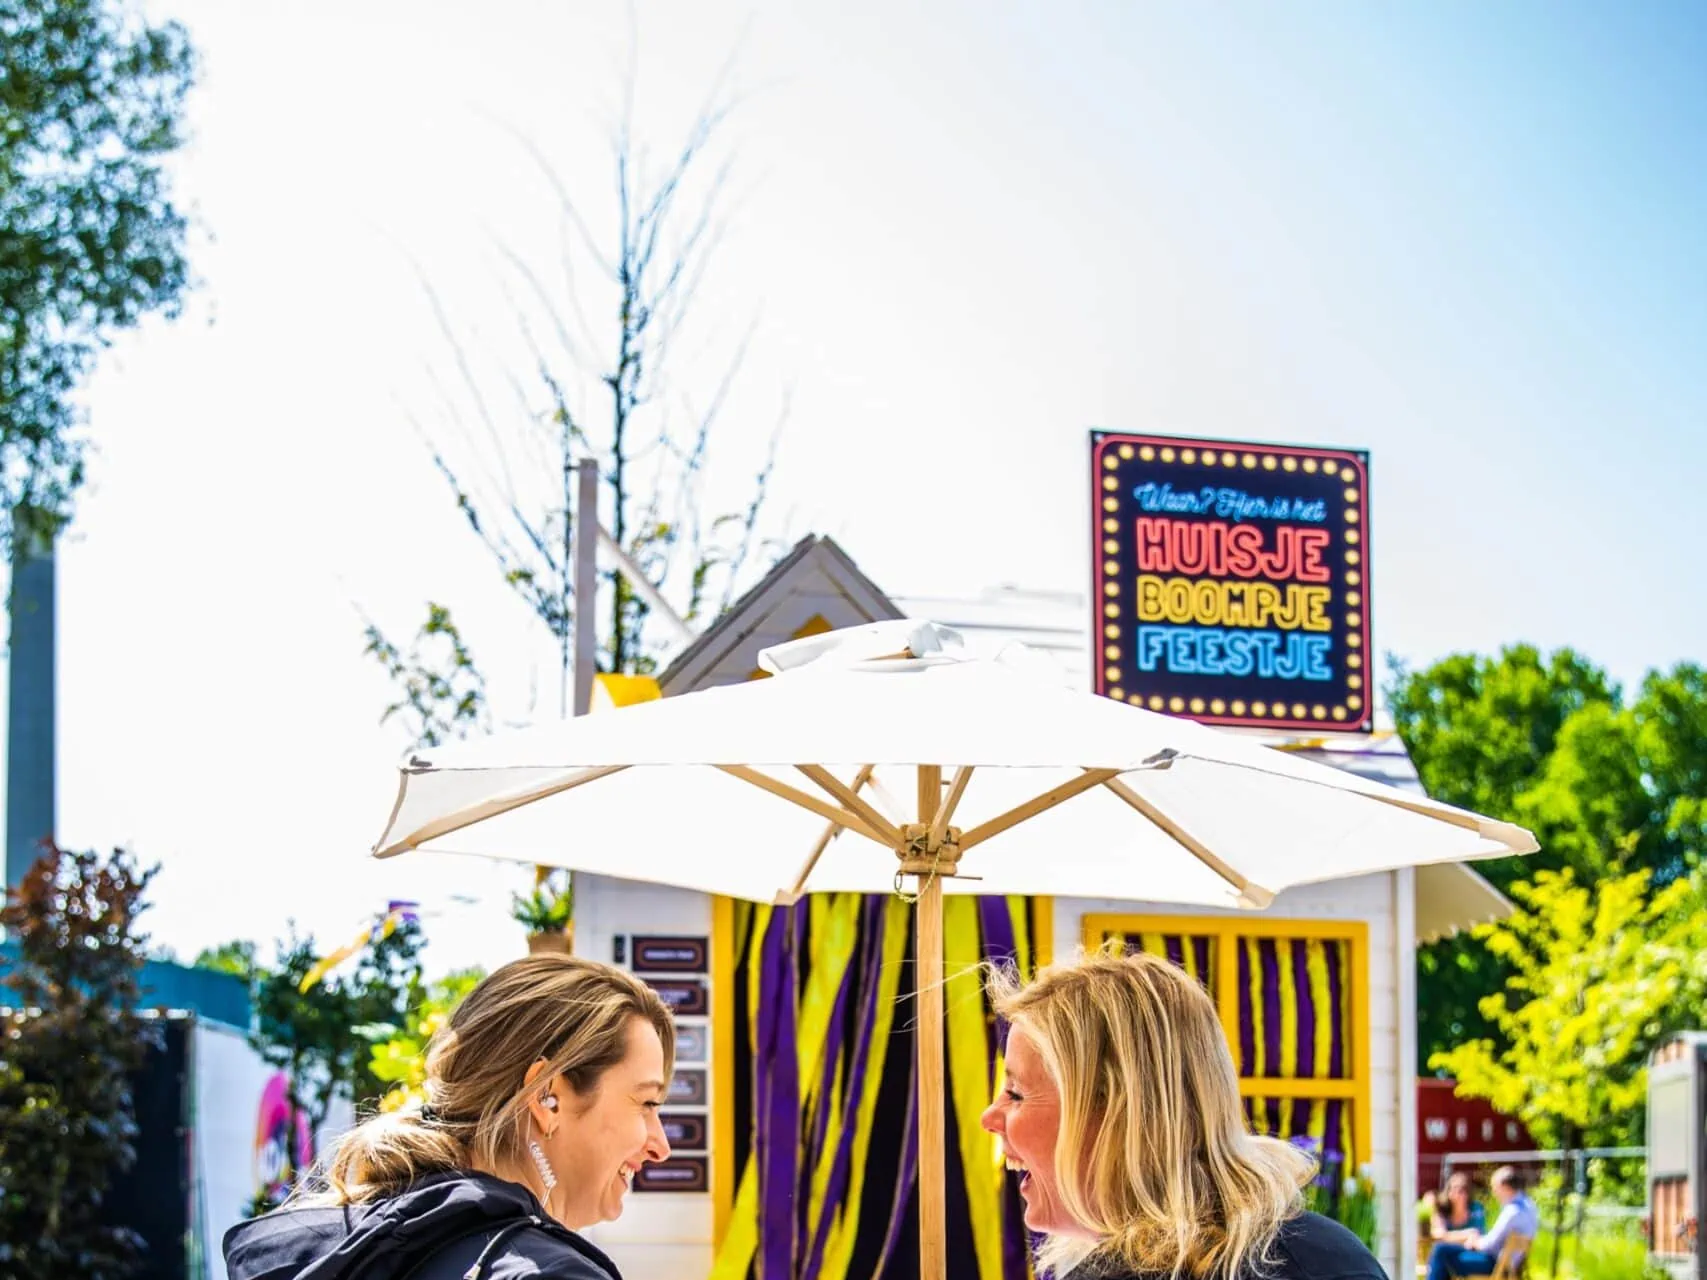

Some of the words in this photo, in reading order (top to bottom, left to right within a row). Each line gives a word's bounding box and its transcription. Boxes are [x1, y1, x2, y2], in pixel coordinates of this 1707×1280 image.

[1135, 518, 1331, 583] HUISJE
[1136, 574, 1332, 631] BOOMPJE
[1137, 625, 1333, 680] FEESTJE
